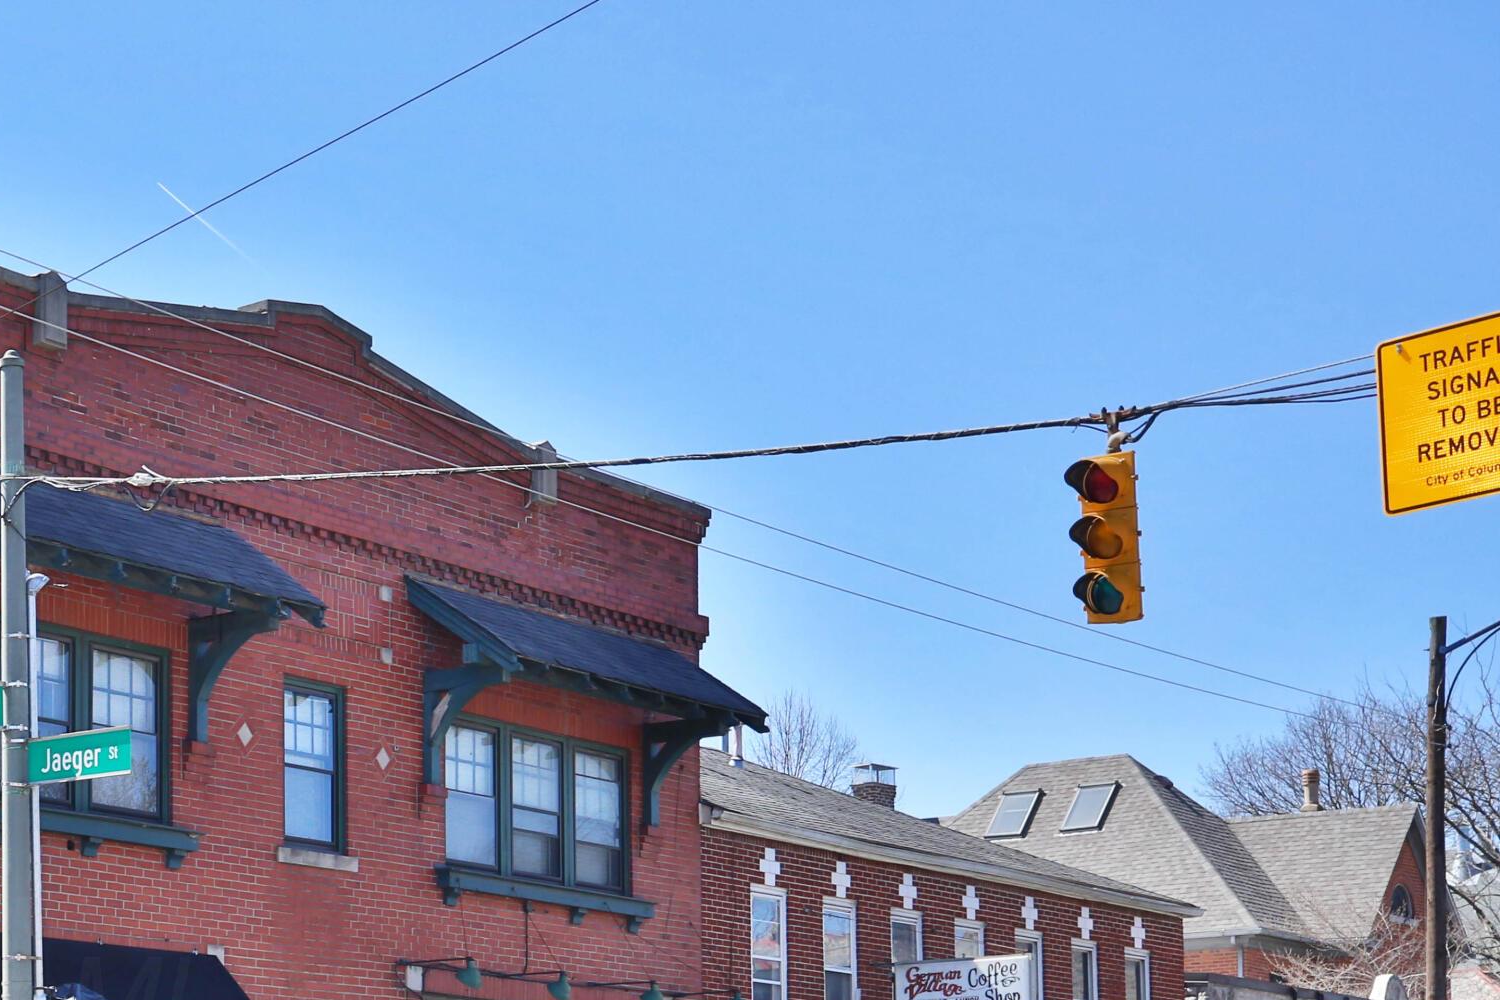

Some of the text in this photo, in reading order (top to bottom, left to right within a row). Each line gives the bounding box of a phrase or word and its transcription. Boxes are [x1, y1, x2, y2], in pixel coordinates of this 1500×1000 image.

[1419, 335, 1500, 373] TRAFFI
[1427, 367, 1500, 401] SIGNA
[1438, 405, 1466, 427] TO
[1417, 427, 1498, 463] REMOV
[1426, 474, 1448, 486] City
[1453, 470, 1464, 481] of
[41, 744, 118, 778] Jaeger St
[906, 966, 962, 983] German
[968, 962, 1017, 988] Coffee
[905, 981, 966, 1000] Village
